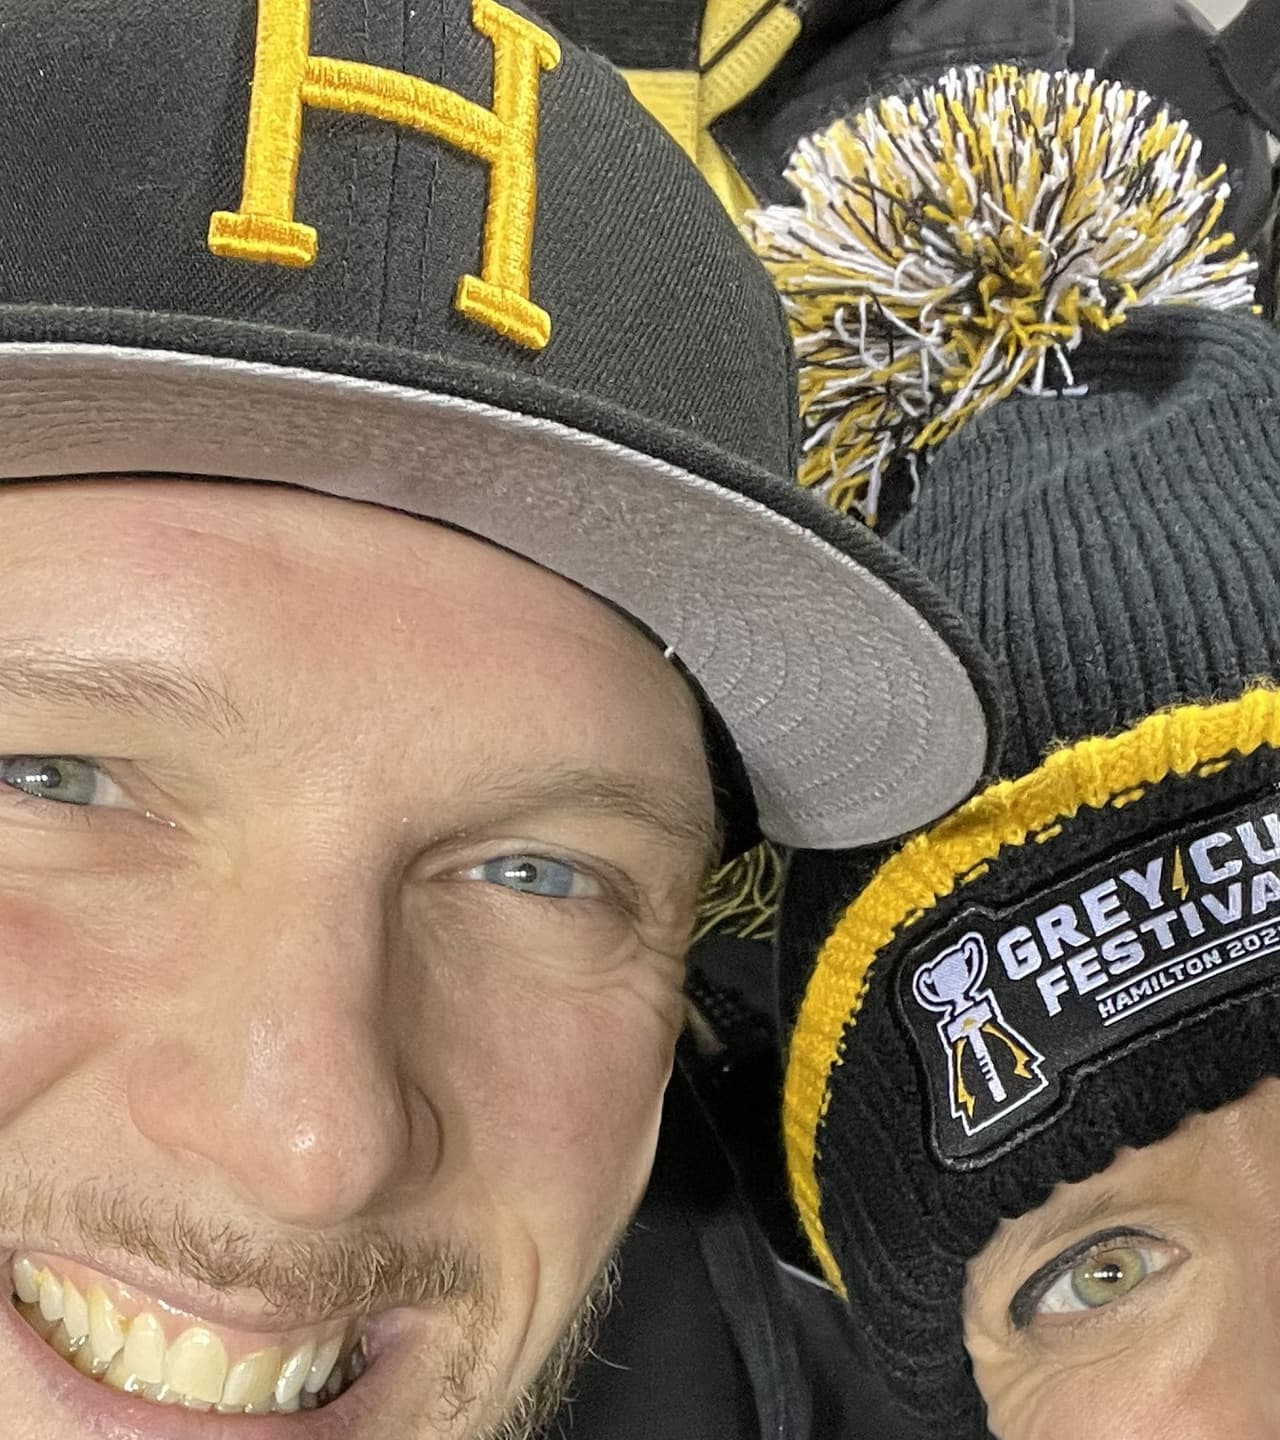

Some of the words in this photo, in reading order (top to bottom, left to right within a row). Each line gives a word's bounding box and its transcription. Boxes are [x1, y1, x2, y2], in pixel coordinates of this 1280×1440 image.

[207, 0, 561, 350] H
[995, 856, 1165, 982] GREY
[1098, 950, 1221, 1018] HAMILTON
